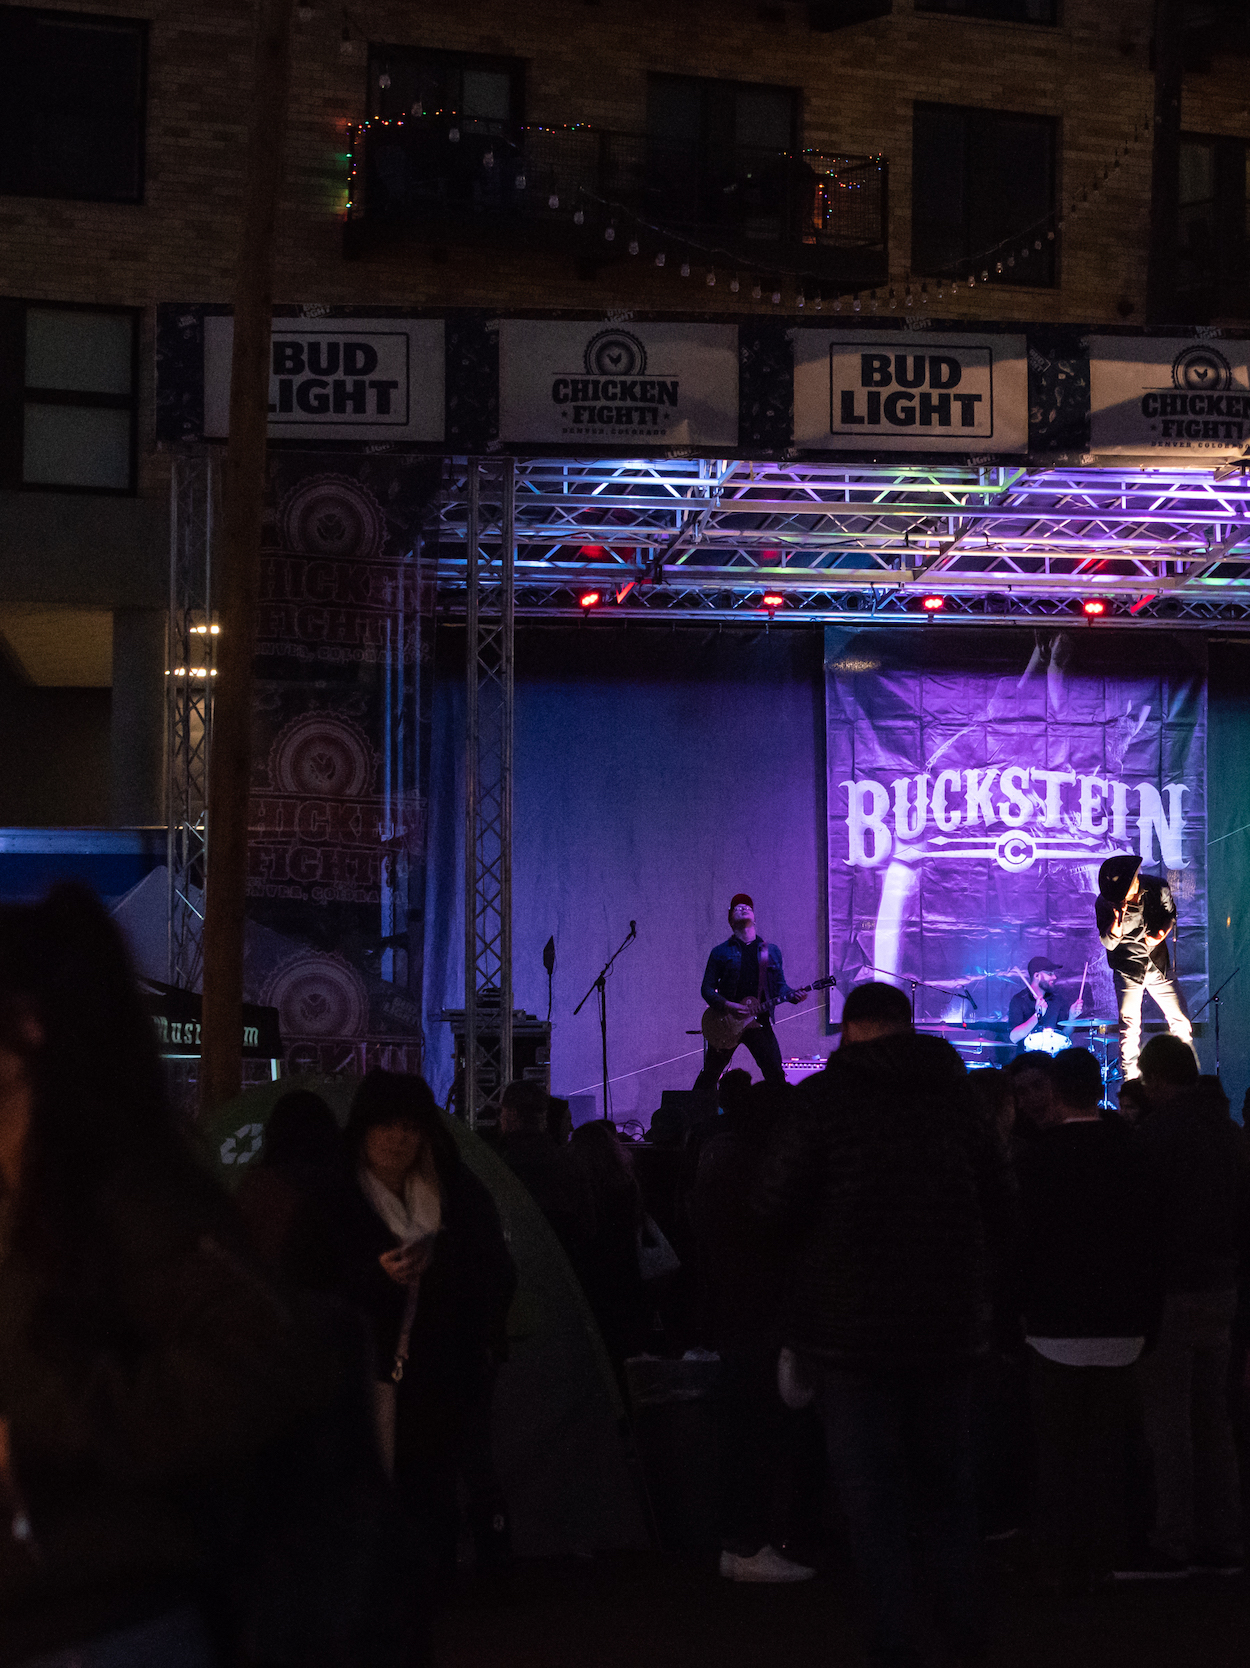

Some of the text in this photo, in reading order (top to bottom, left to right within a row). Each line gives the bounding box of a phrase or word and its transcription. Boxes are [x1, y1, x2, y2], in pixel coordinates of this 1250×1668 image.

[272, 341, 379, 377] BUD
[860, 353, 963, 389] BUD
[267, 378, 399, 415] IGHT
[552, 378, 680, 407] CHICKEN
[841, 390, 983, 427] LIGHT
[572, 405, 660, 426] FIGHT!
[1161, 419, 1245, 440] FIGHT!
[838, 765, 1192, 871] BUCKSTEIN
